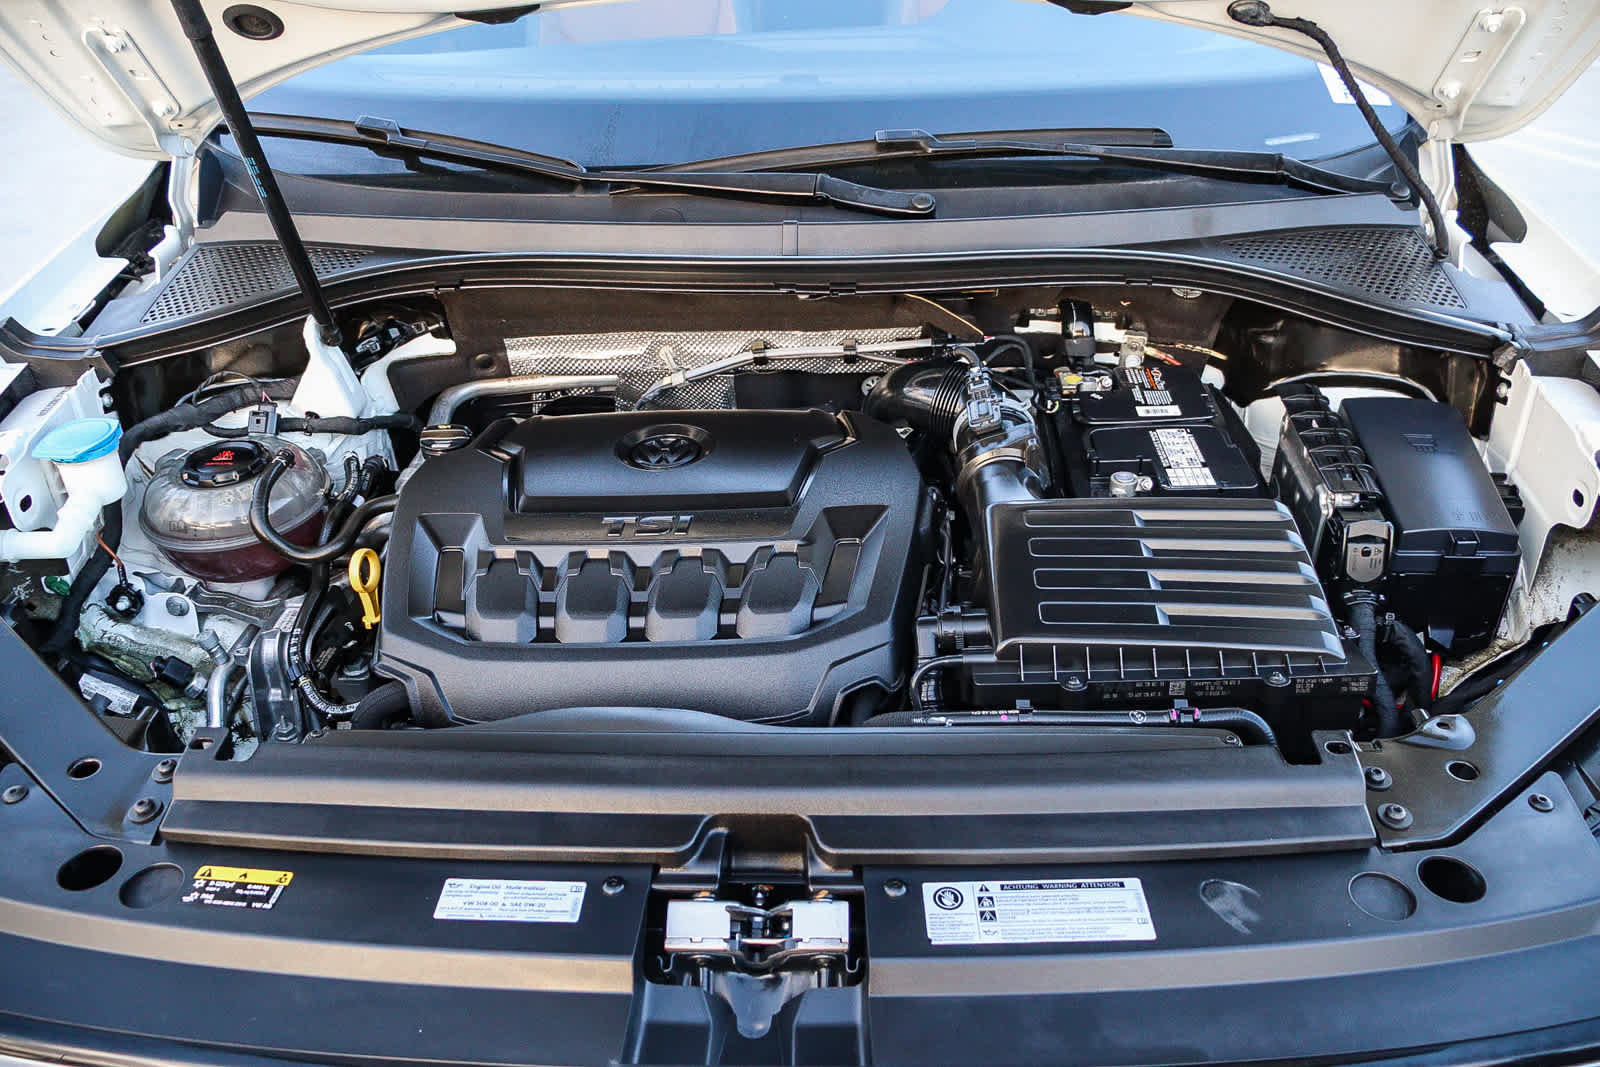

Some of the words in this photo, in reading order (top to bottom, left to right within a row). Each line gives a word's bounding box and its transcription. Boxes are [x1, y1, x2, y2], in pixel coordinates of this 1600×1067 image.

[601, 514, 694, 537] TSI
[1002, 883, 1039, 891] ACHTUNG
[1041, 882, 1078, 890] WARNING
[1080, 881, 1121, 889] ATTENTION
